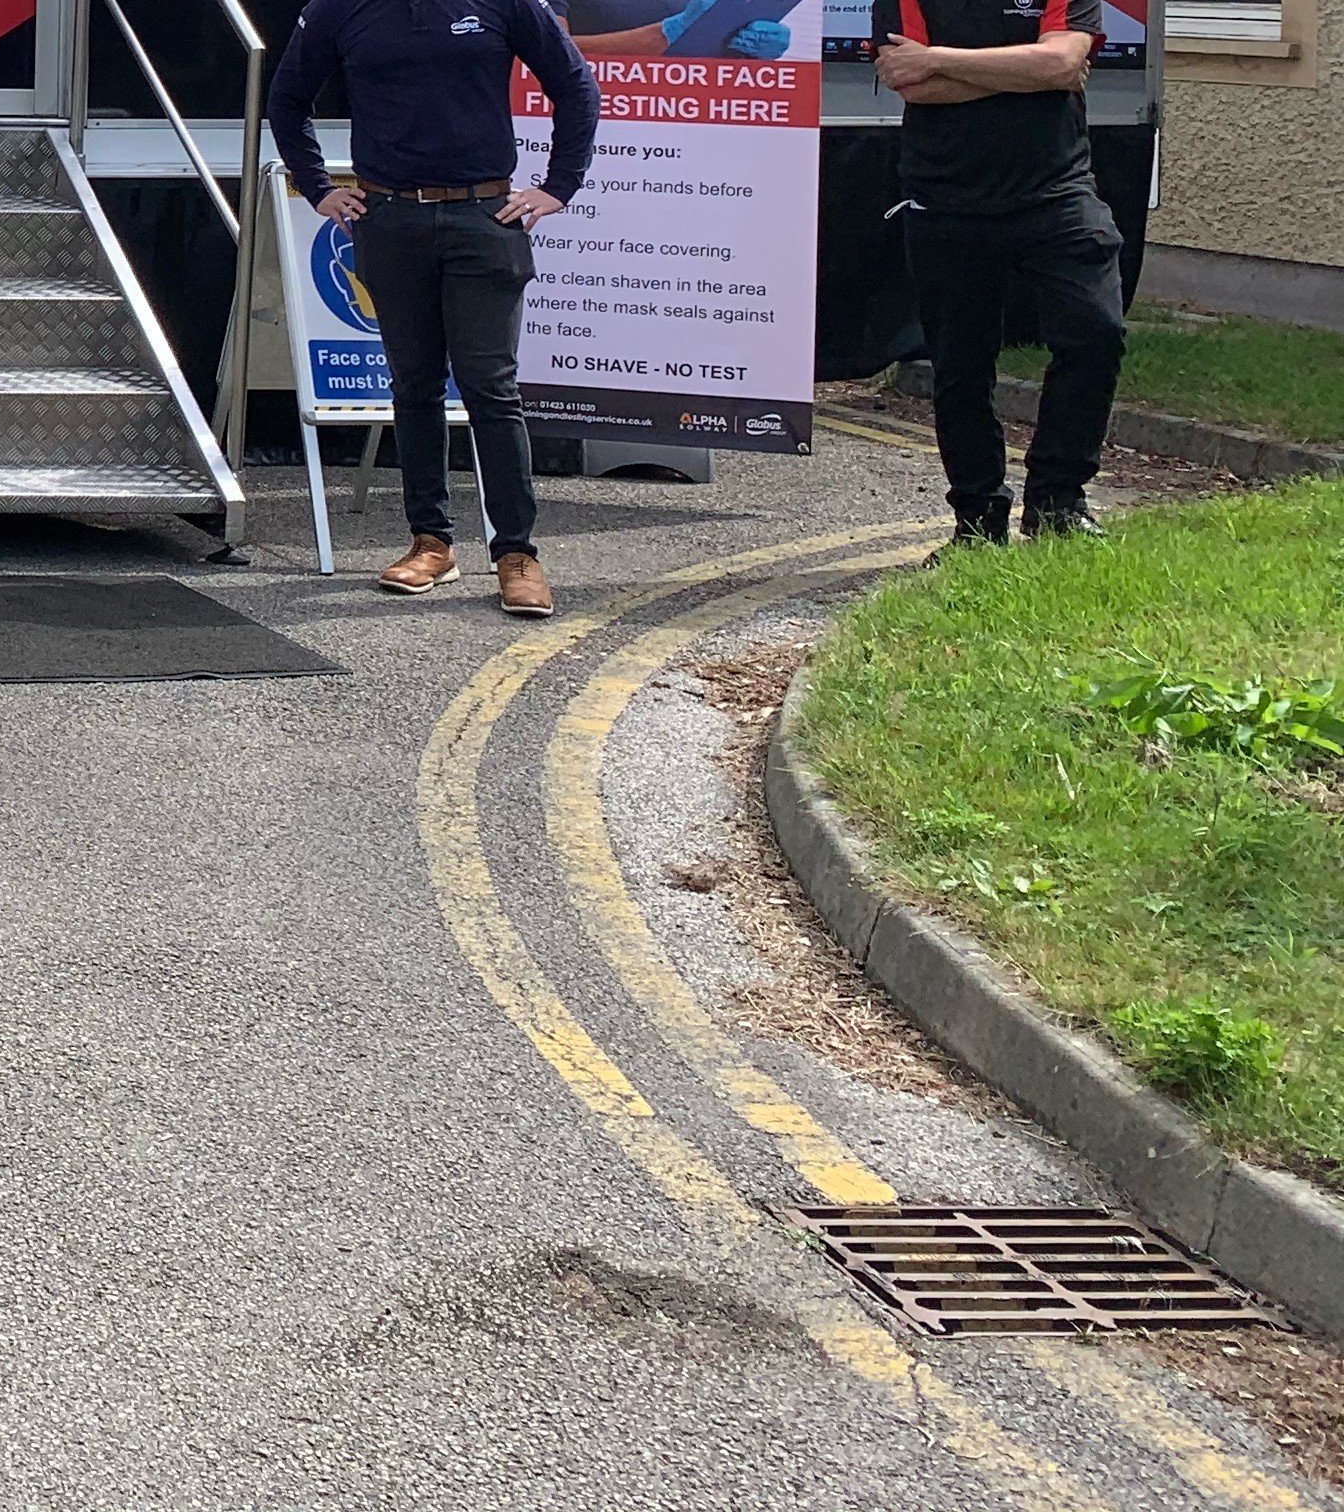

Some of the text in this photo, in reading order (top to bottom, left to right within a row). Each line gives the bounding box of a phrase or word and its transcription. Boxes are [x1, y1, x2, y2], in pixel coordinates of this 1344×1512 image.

[716, 62, 796, 90] FACE
[598, 94, 790, 123] ESTING HERE
[642, 146, 681, 162] you:
[600, 180, 638, 194] your
[642, 178, 694, 195] hands
[699, 181, 753, 198] before
[529, 235, 736, 262] Wear your face covering.
[561, 271, 766, 296] clean shaven in the area
[526, 295, 775, 324] where the mask seals against
[526, 320, 596, 338] the face.
[317, 349, 361, 366] Face
[551, 354, 748, 381] NO SHAVE NO TEST
[328, 374, 374, 389] must
[679, 412, 728, 427] ALPHA
